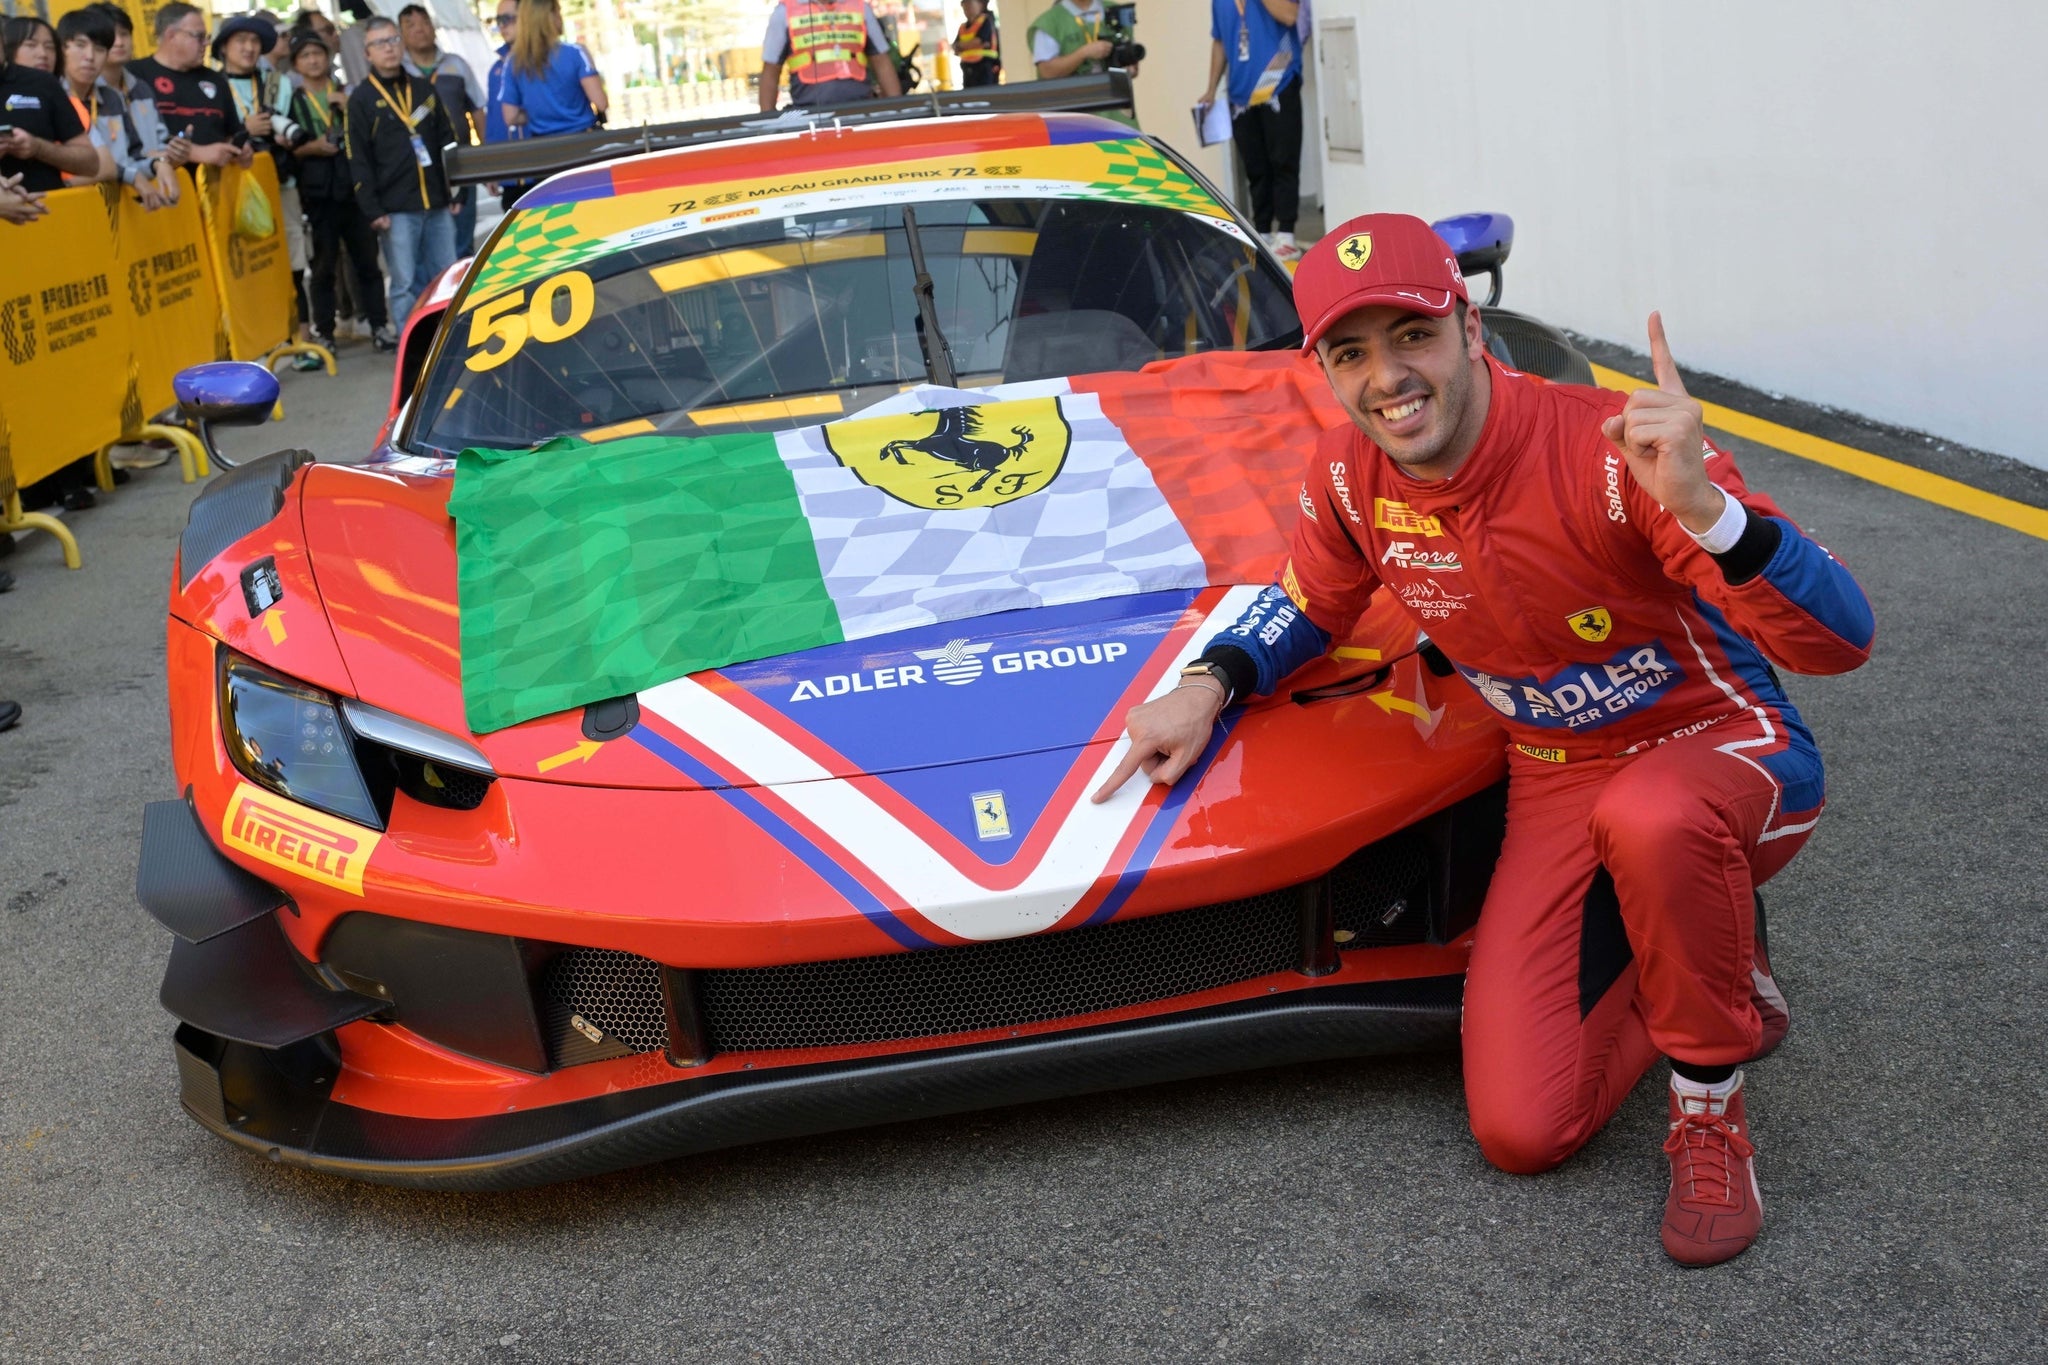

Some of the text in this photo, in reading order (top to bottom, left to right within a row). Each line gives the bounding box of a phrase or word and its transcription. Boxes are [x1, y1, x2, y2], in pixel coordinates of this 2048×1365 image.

[668, 167, 978, 214] 72 MACAU GRAND PRIX 72
[464, 270, 595, 373] 50
[1329, 461, 1361, 525] Sabelt
[1604, 453, 1627, 524] Sabelt
[1421, 608, 1450, 620] group
[789, 642, 1128, 702] ADLER GROUP
[1520, 647, 1668, 714] ADLER
[231, 796, 359, 880] PIRELLI
